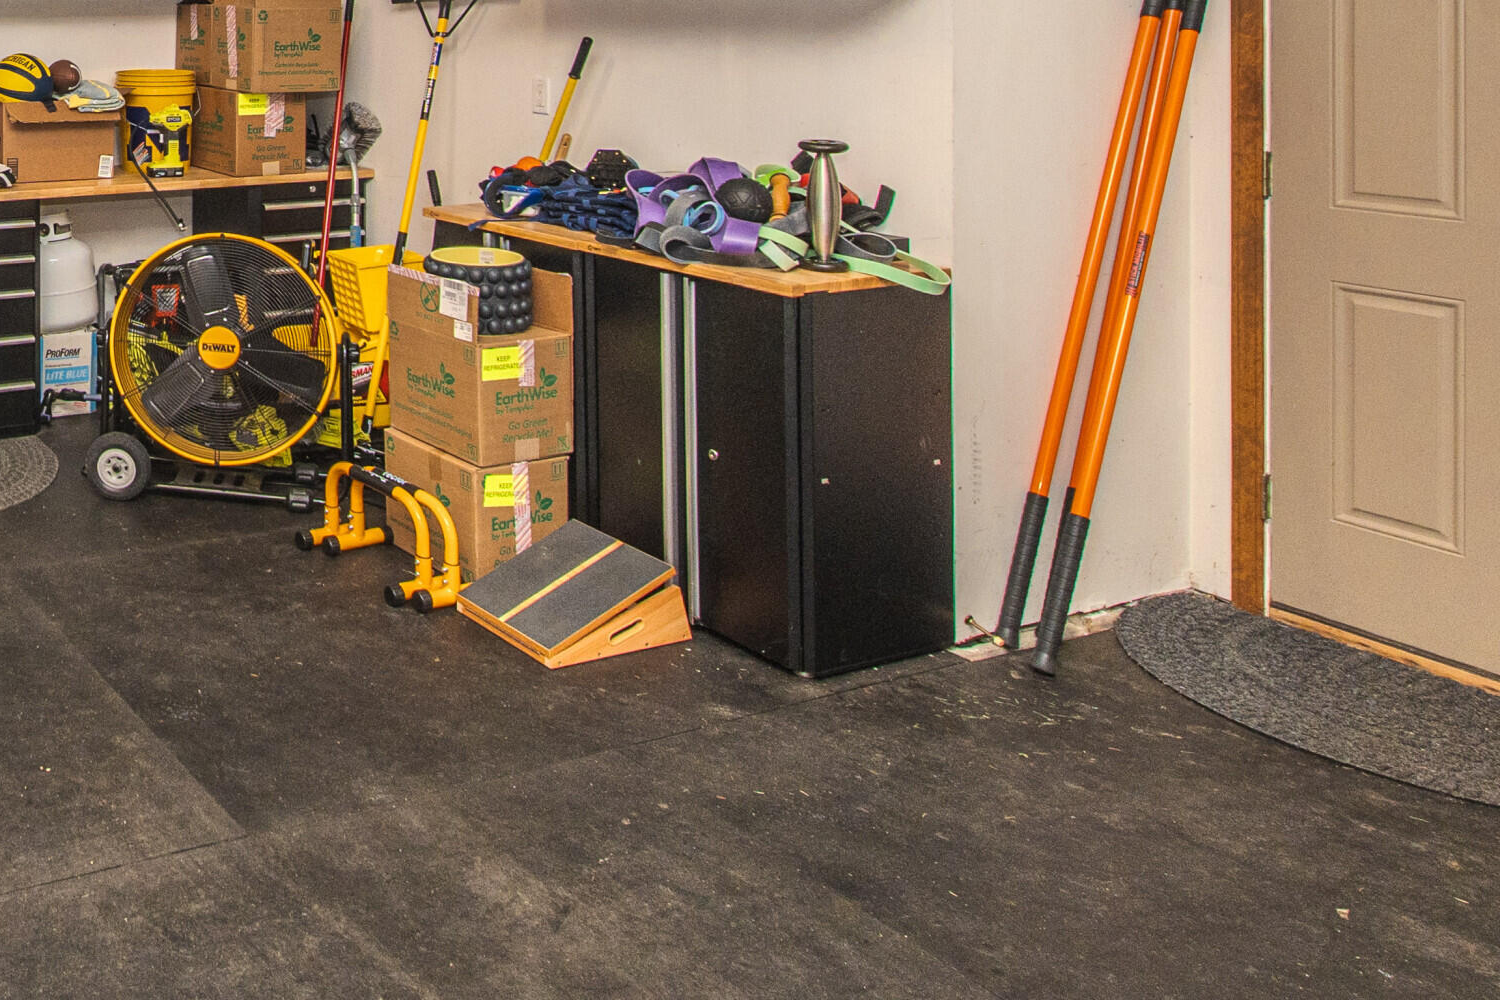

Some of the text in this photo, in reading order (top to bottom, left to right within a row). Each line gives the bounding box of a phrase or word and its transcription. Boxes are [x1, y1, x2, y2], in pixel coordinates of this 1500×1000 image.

[274, 40, 322, 51] EarthWise
[483, 362, 520, 371] REFRIGERATE
[46, 369, 87, 380] LITE BLUE
[406, 367, 456, 398] EarthWise
[495, 386, 558, 406] EarthWise
[508, 421, 520, 430] Go
